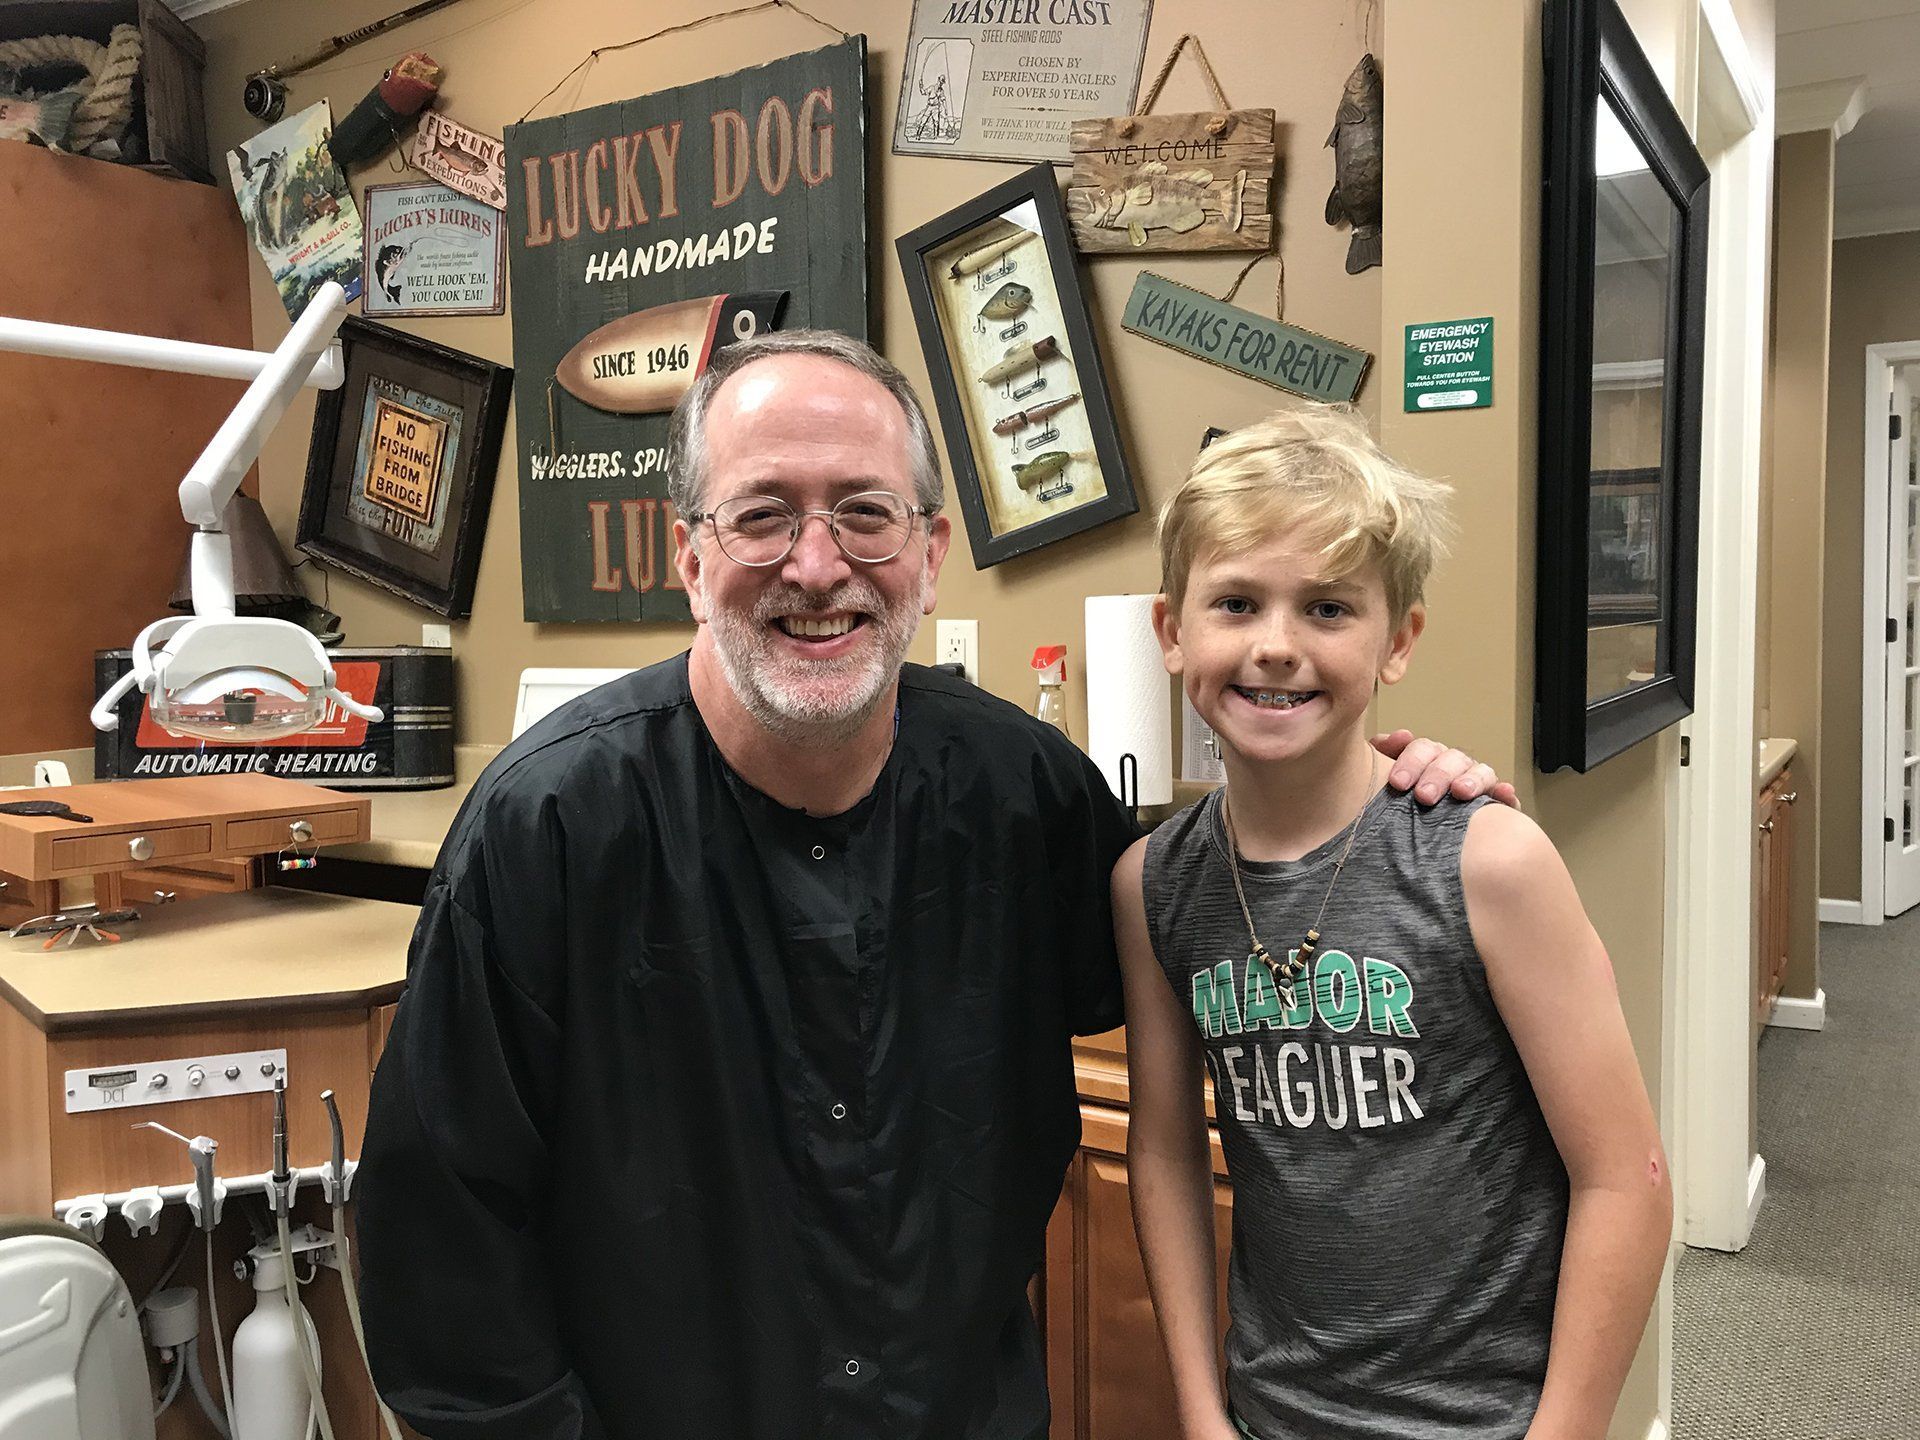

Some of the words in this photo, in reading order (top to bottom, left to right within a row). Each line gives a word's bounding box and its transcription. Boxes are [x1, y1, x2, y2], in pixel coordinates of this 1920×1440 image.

[941, 0, 1040, 24] MASTER
[1049, 0, 1112, 26] CAST
[981, 29, 1003, 42] STEEL
[1005, 30, 1038, 43] FISHING
[1039, 30, 1062, 44] RODS
[1018, 56, 1064, 68] CHOSEN
[1066, 57, 1082, 68] BY
[982, 70, 1059, 84] EXPERIENCED
[1061, 73, 1117, 86] ANGLERS
[992, 86, 1014, 98] FOR
[1016, 87, 1046, 98] OVER
[1049, 88, 1060, 99] 50
[1062, 89, 1100, 101] YEARS
[981, 118, 995, 127] WE
[996, 118, 1024, 128] THINK
[1024, 120, 1044, 129] YOU
[1045, 120, 1068, 130] WILL
[983, 130, 1005, 140] WITH
[1006, 131, 1033, 141] THEIR
[1103, 138, 1228, 166] WELCOME
[522, 121, 682, 248] LUCKY
[710, 86, 835, 208] DOG
[426, 158, 488, 196] EXPEDITIONS
[398, 197, 414, 206] FISH
[374, 208, 436, 244] LUCKY'S
[439, 208, 492, 238] LURES
[288, 245, 313, 264] WRIGHT
[585, 217, 778, 284] HANDMADE
[407, 274, 434, 286] WE'LL
[437, 274, 466, 286] HOOK
[412, 291, 431, 302] YOU
[433, 290, 460, 302] COOK
[1411, 322, 1489, 340] EMERGENCY
[1136, 290, 1228, 352] KAYAKS
[1224, 322, 1276, 370] FOR
[1274, 340, 1349, 392] RENT
[1418, 337, 1480, 353] EYEWASH
[593, 351, 636, 380] SINCE
[647, 343, 689, 374] 1946
[1423, 351, 1474, 366] STATION
[1406, 380, 1434, 388] TOWARDS
[1462, 376, 1490, 384] EYEWASH
[1432, 372, 1455, 380] CENTER
[1456, 370, 1480, 378] BUTTON
[396, 420, 416, 440] NO
[380, 436, 431, 467] FISHING
[384, 458, 420, 485] FROM
[531, 450, 626, 480] WIGGLERS,
[376, 476, 423, 508] BRIDGE
[382, 507, 416, 542] FUN
[134, 754, 269, 774] AUTOMATIC
[274, 753, 377, 774] HEATING
[1192, 948, 1420, 1040] MAJOR
[103, 1090, 125, 1104] DCI
